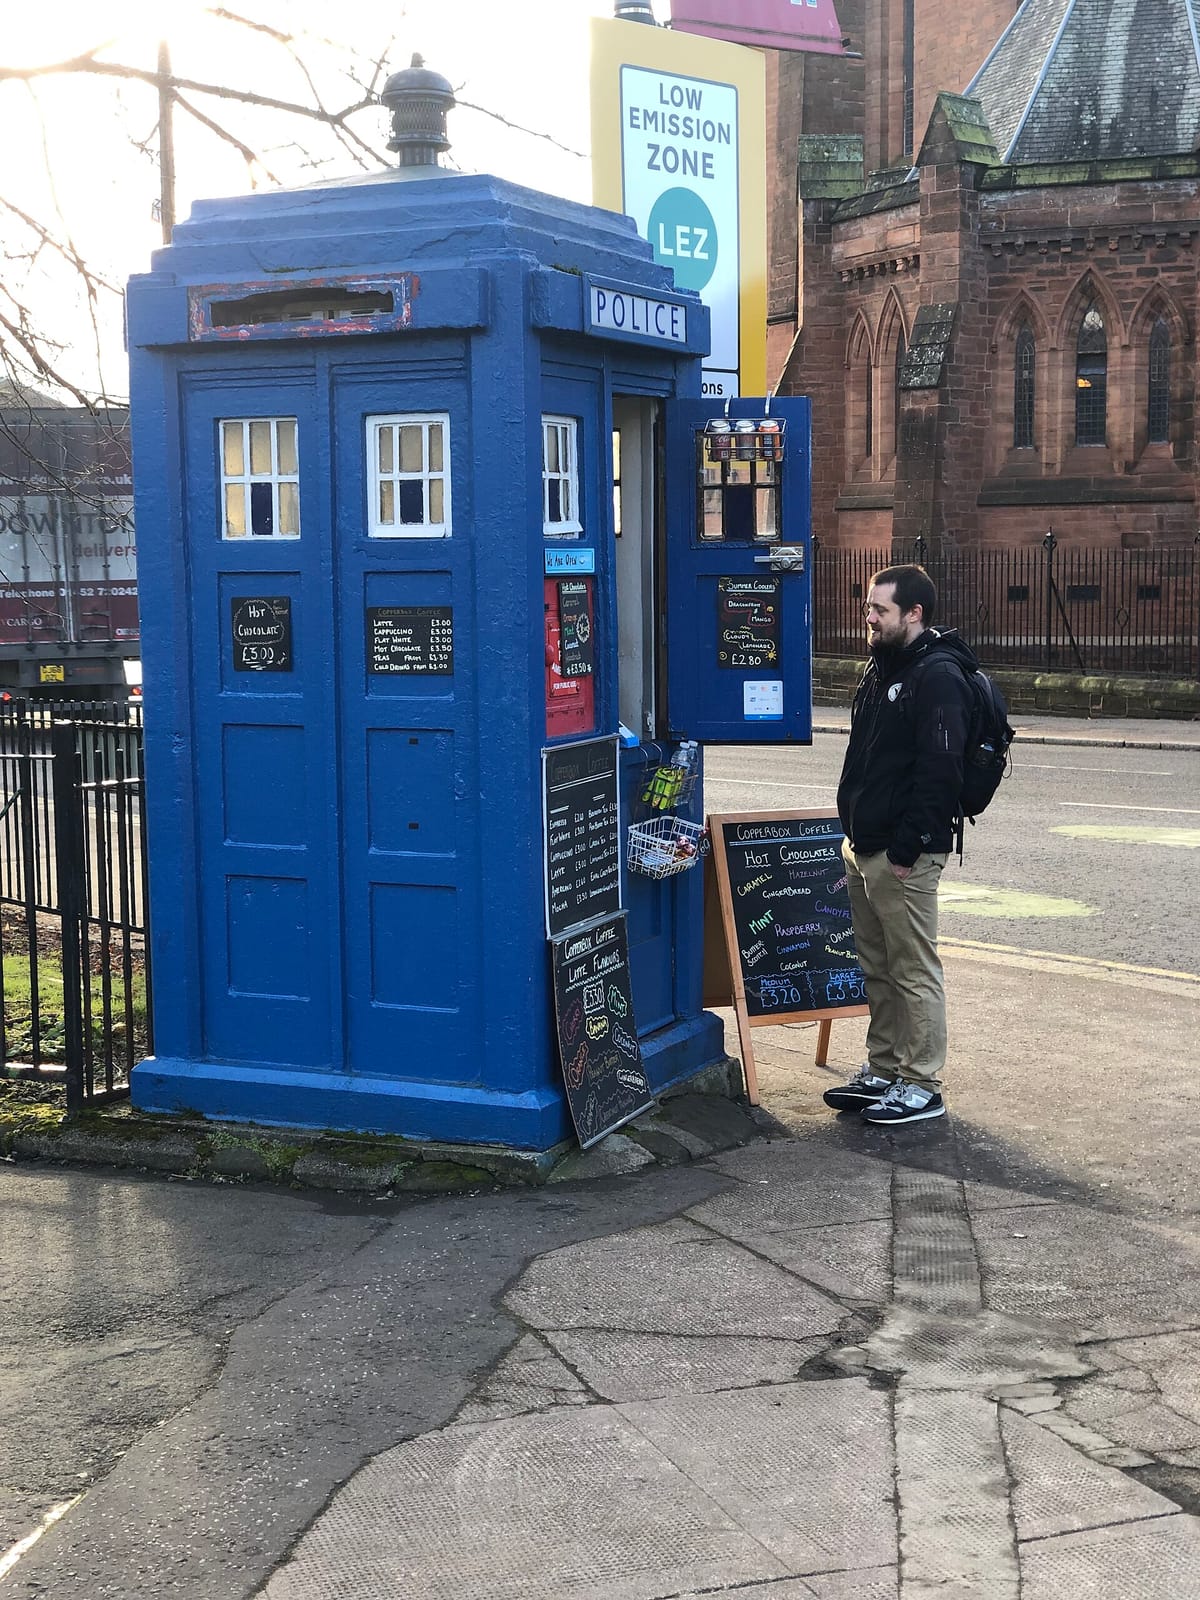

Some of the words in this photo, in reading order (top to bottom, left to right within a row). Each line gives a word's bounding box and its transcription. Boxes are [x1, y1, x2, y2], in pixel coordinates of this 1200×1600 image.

[659, 82, 703, 111] LOW
[629, 106, 731, 145] EMISSION
[647, 142, 715, 180] ZONE
[658, 222, 709, 261] LEZ
[597, 290, 679, 338] POLICE
[248, 605, 266, 618] HOT
[238, 624, 280, 637] CHOCOLATE
[373, 619, 394, 627] LATTE
[374, 628, 413, 636] CAPPUCCINO
[374, 645, 388, 653] HOT
[390, 644, 422, 653] CHOCOLATE
[430, 644, 452, 652] £3.50
[736, 824, 791, 841] COPPERBOX
[798, 822, 833, 837] COFFEE
[744, 850, 769, 866] HOT
[779, 845, 836, 862] CHOCOLATES
[788, 867, 830, 880] HAZELNUT
[737, 872, 773, 897] CARAMEL
[762, 886, 812, 899] GINGERBREAD
[748, 909, 775, 935] MINT
[774, 922, 821, 937] RASPBERRY
[595, 927, 616, 945] COFFEE
[776, 939, 811, 955] CINNAMON
[568, 963, 588, 983] LATTE
[593, 949, 620, 972] FLAVOURS
[780, 959, 808, 972] COCONUT
[760, 978, 791, 986] MEDIUM
[829, 971, 857, 980] LARGE
[610, 989, 625, 1013] MINT
